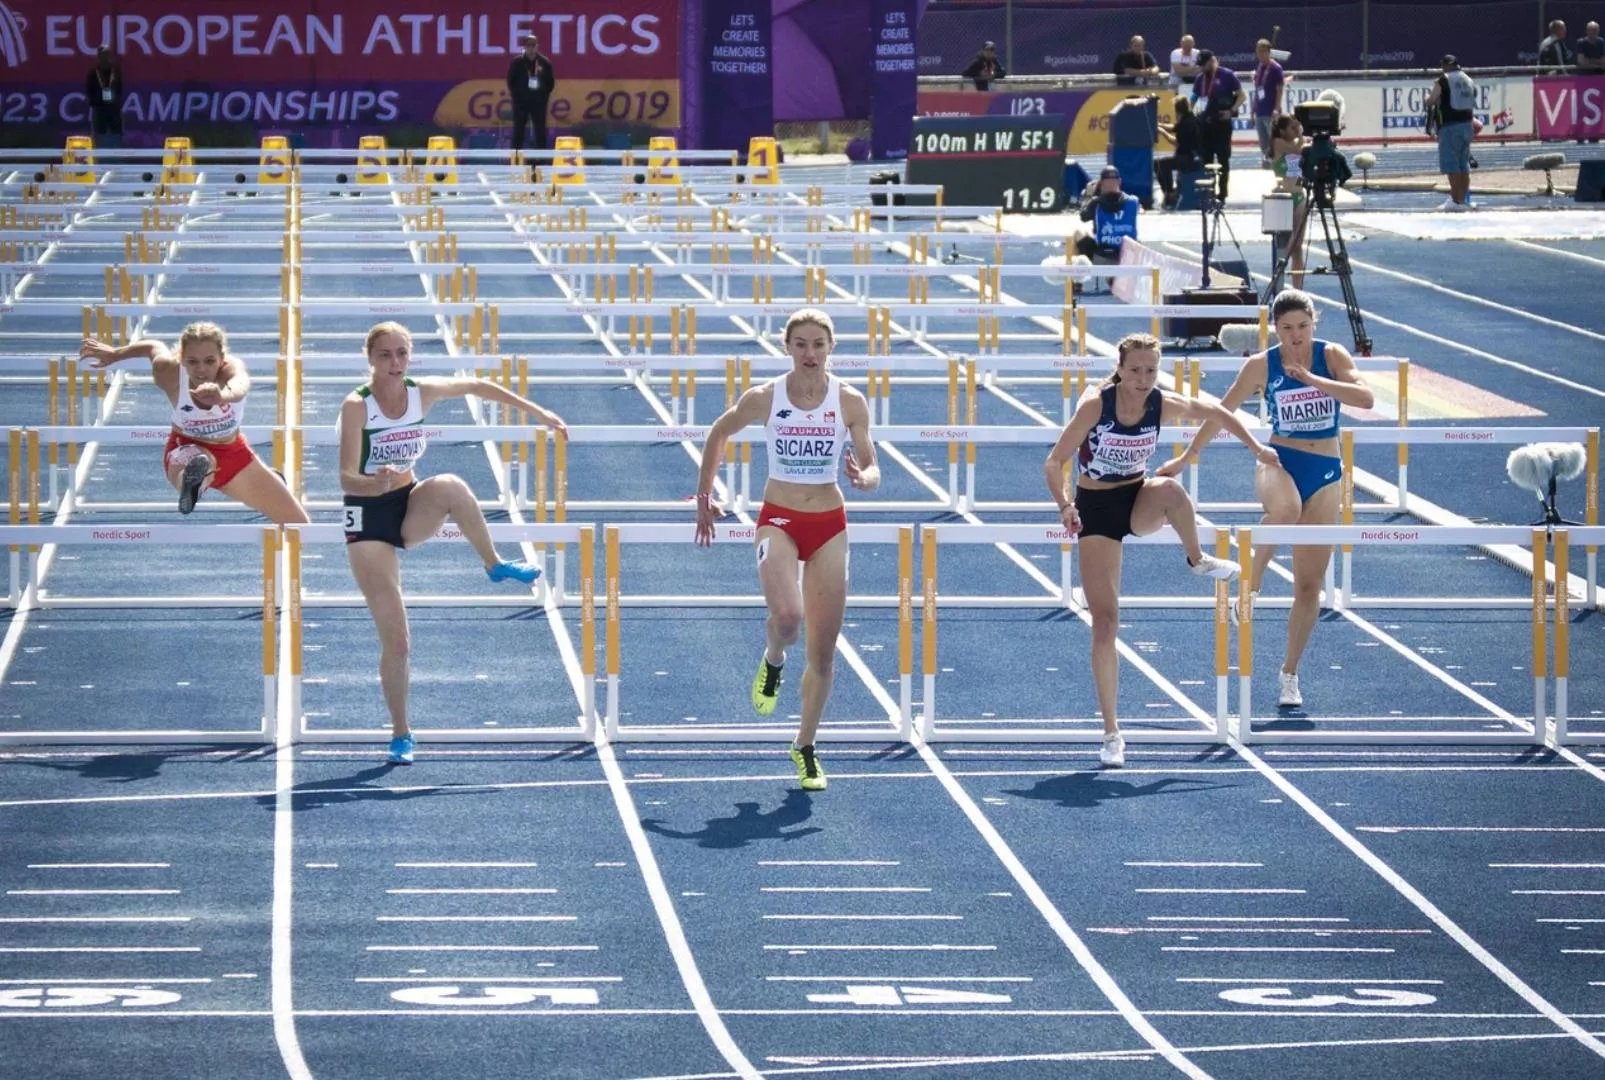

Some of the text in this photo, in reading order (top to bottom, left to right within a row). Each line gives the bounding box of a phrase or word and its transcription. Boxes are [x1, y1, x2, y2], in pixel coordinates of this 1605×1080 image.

[731, 15, 754, 25] LET'S
[46, 14, 660, 55] EUROPEAN ATHLETICS
[722, 31, 760, 41] CREATE
[881, 28, 909, 38] CREATE
[713, 47, 765, 57] MEMORIES
[876, 44, 914, 55] MEMORIES
[711, 62, 766, 73] TOGETHER!
[59, 91, 399, 122] CAMPIONSHIPS
[583, 91, 669, 120] 2019
[1539, 88, 1600, 126] VIS
[915, 131, 1054, 152] 100m H W SF1
[1003, 187, 1055, 209] 11.9
[1281, 400, 1332, 420] MARINI
[424, 431, 442, 439] port
[684, 431, 704, 440] Sport
[784, 426, 835, 435] BAUHAUS
[947, 431, 968, 439] Sport
[1472, 432, 1493, 440] Sport
[776, 438, 834, 457] SICIARZ
[345, 510, 355, 528] 5
[93, 531, 150, 540] Nordic Sport
[1361, 531, 1419, 541] Nordic Sport
[389, 985, 600, 1006] 5
[805, 985, 1013, 1006] 4
[1217, 987, 1438, 1009] 3
